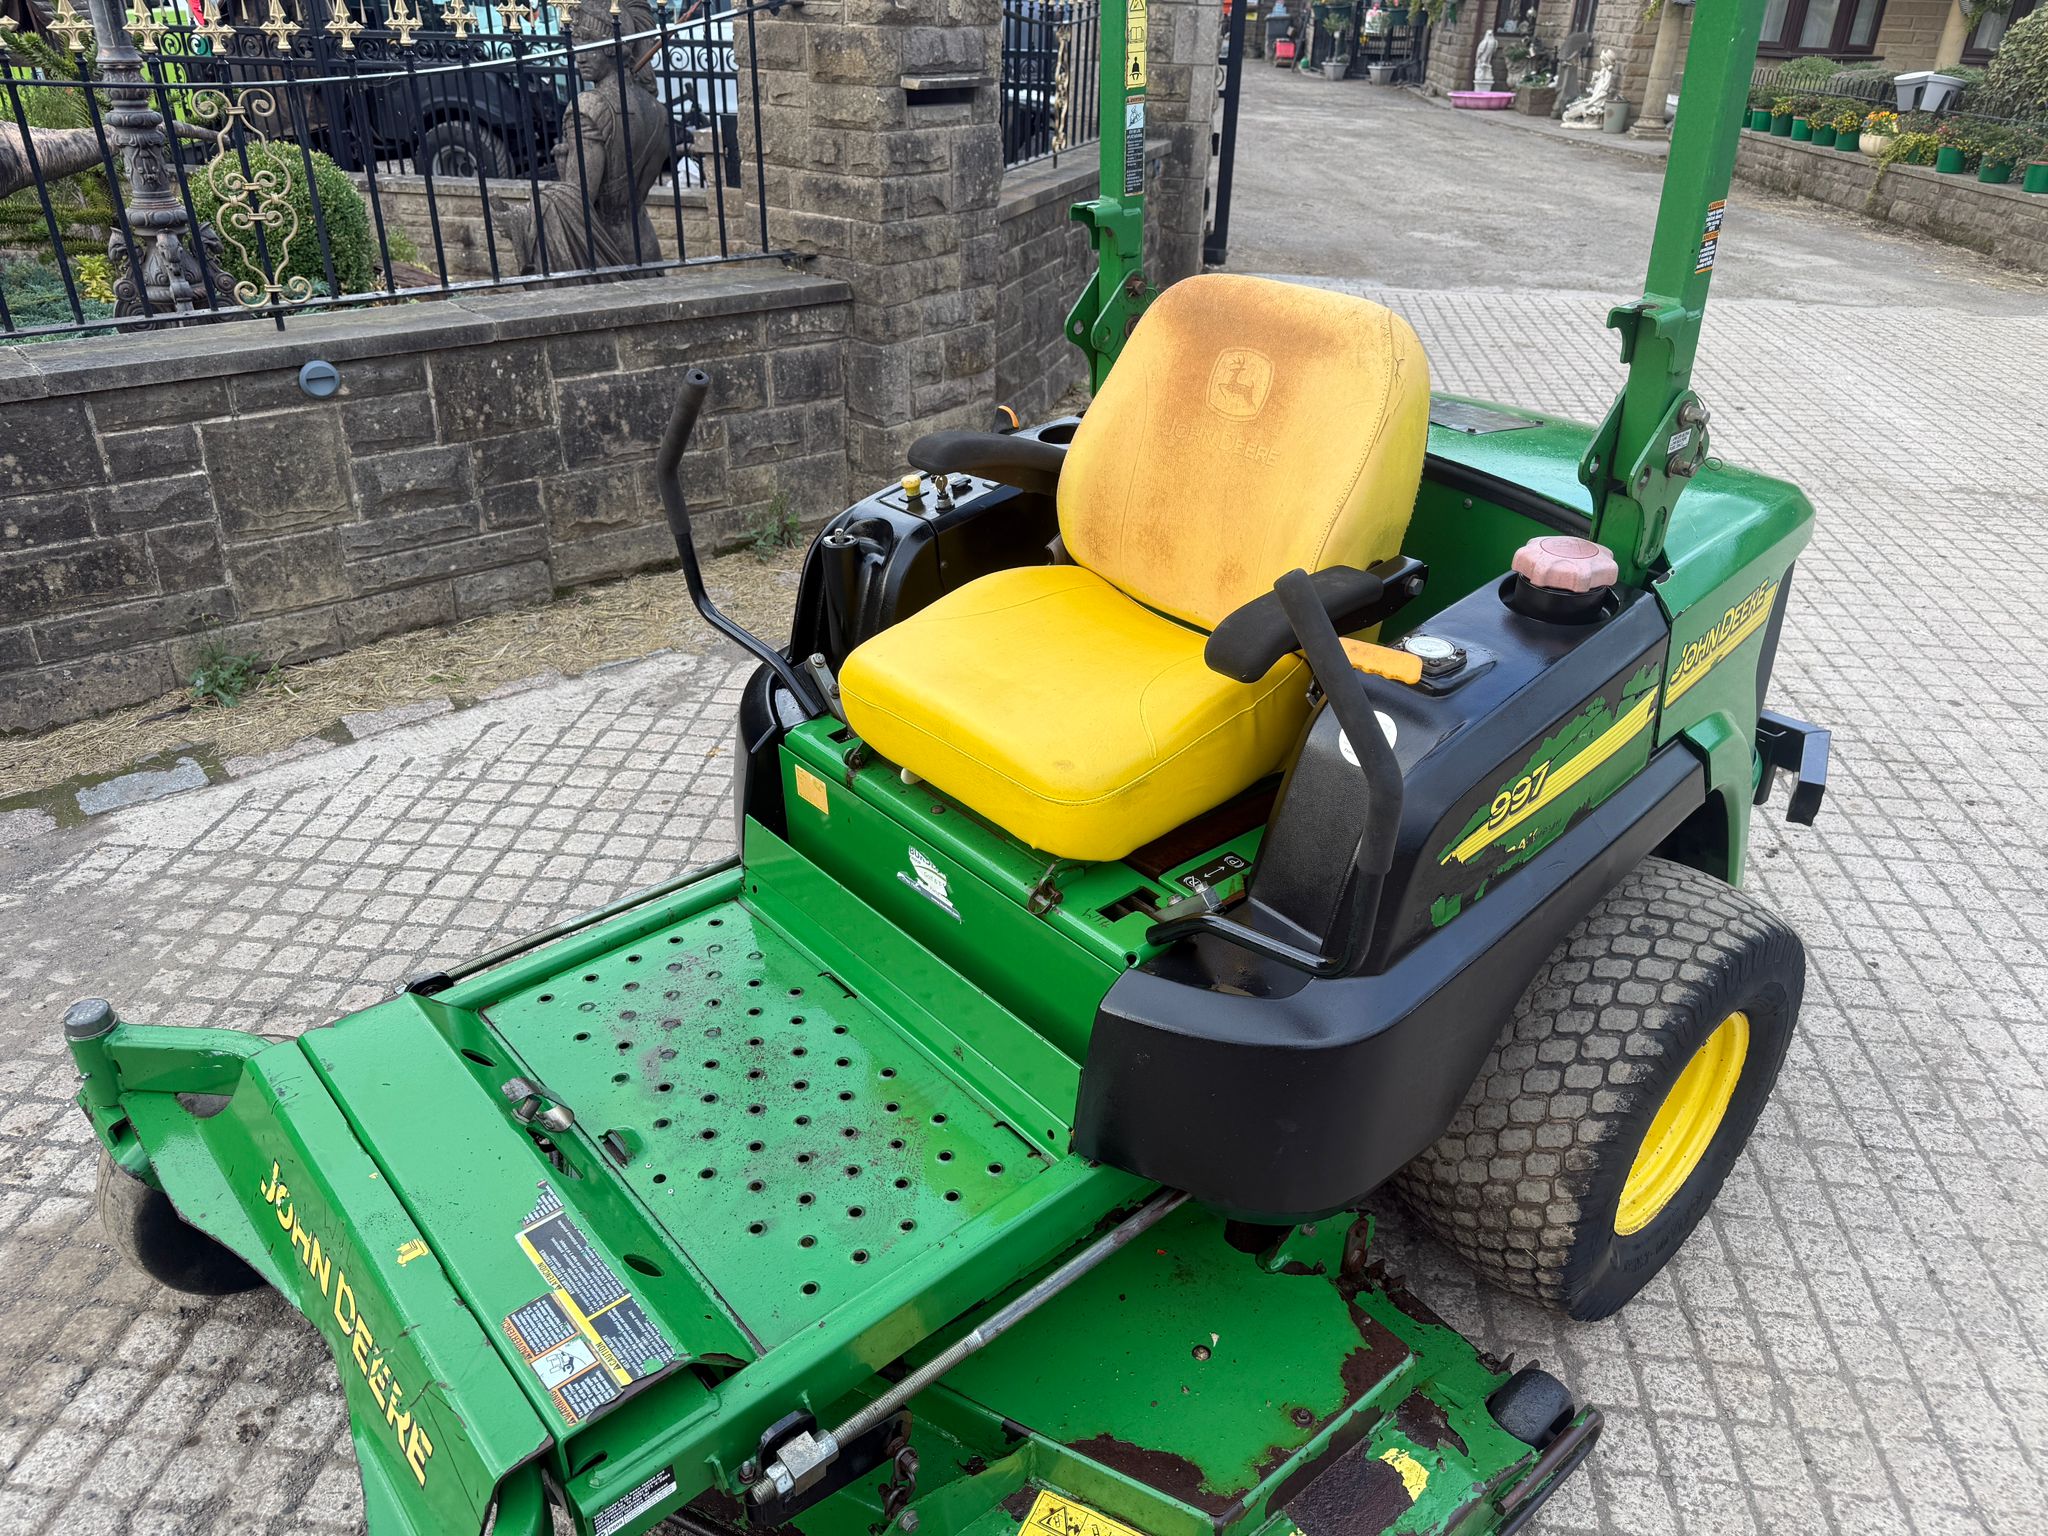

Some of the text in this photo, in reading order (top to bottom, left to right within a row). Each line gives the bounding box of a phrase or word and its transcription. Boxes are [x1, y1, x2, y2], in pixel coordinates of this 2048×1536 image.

[1161, 419, 1281, 468] JOHN DEERE
[1670, 578, 1769, 684] JOHN DEERE
[1488, 760, 1550, 830] 997
[536, 1261, 558, 1286] ATENCION
[260, 1160, 433, 1489] JOHN DEERE
[594, 1341, 617, 1366] CAUTION
